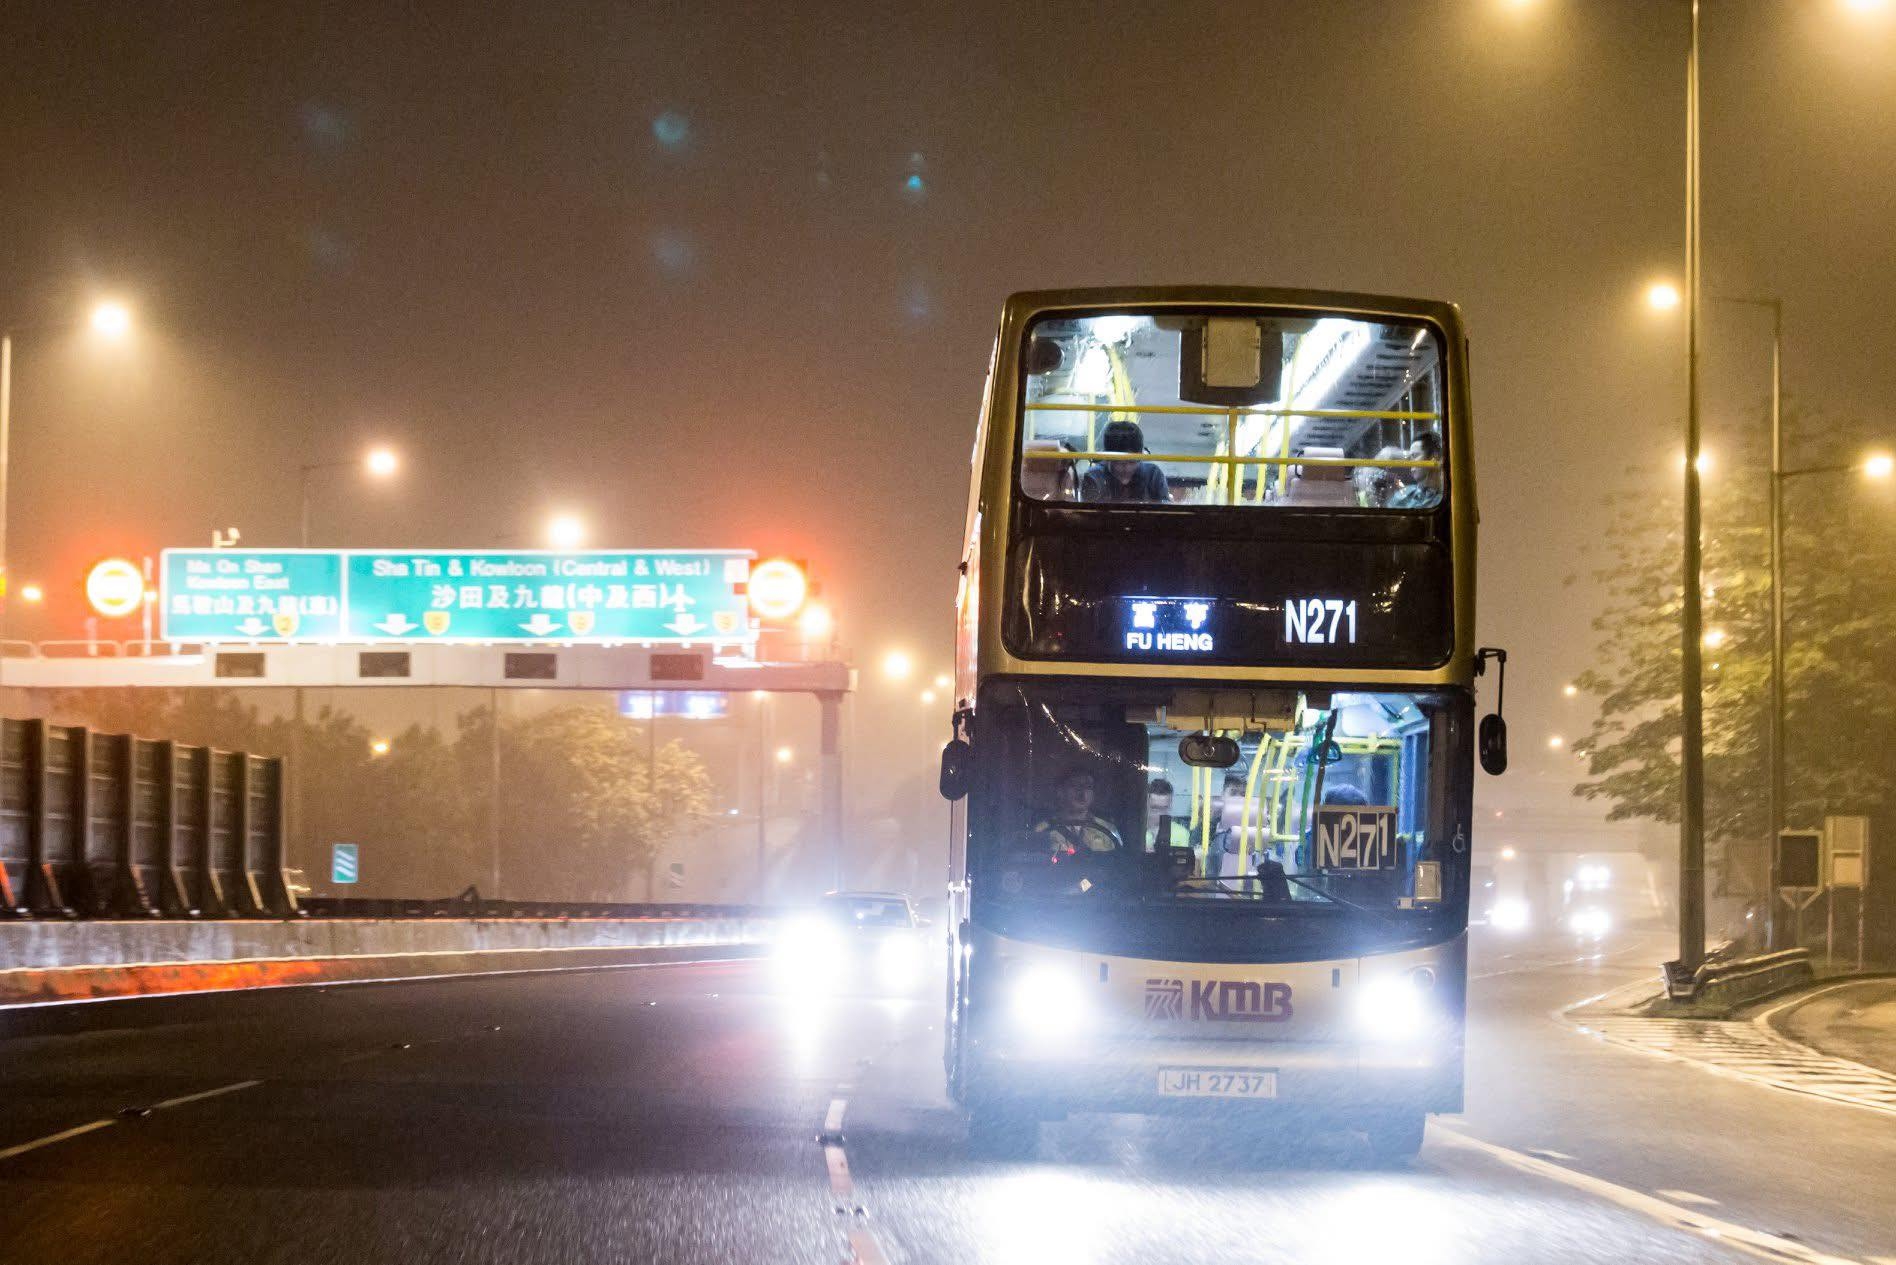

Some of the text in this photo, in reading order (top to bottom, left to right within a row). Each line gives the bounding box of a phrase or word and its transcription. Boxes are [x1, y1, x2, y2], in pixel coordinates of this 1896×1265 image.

[372, 558, 409, 576] Sha
[411, 558, 441, 576] Tin
[448, 558, 464, 576] &
[470, 559, 547, 576] Kowloon
[633, 558, 649, 577] &
[1285, 598, 1356, 644] N271
[1126, 632, 1213, 651] FU HENG
[1319, 813, 1389, 868] N271
[1190, 979, 1294, 1023] KMB
[1173, 1072, 1265, 1093] JH 2737
